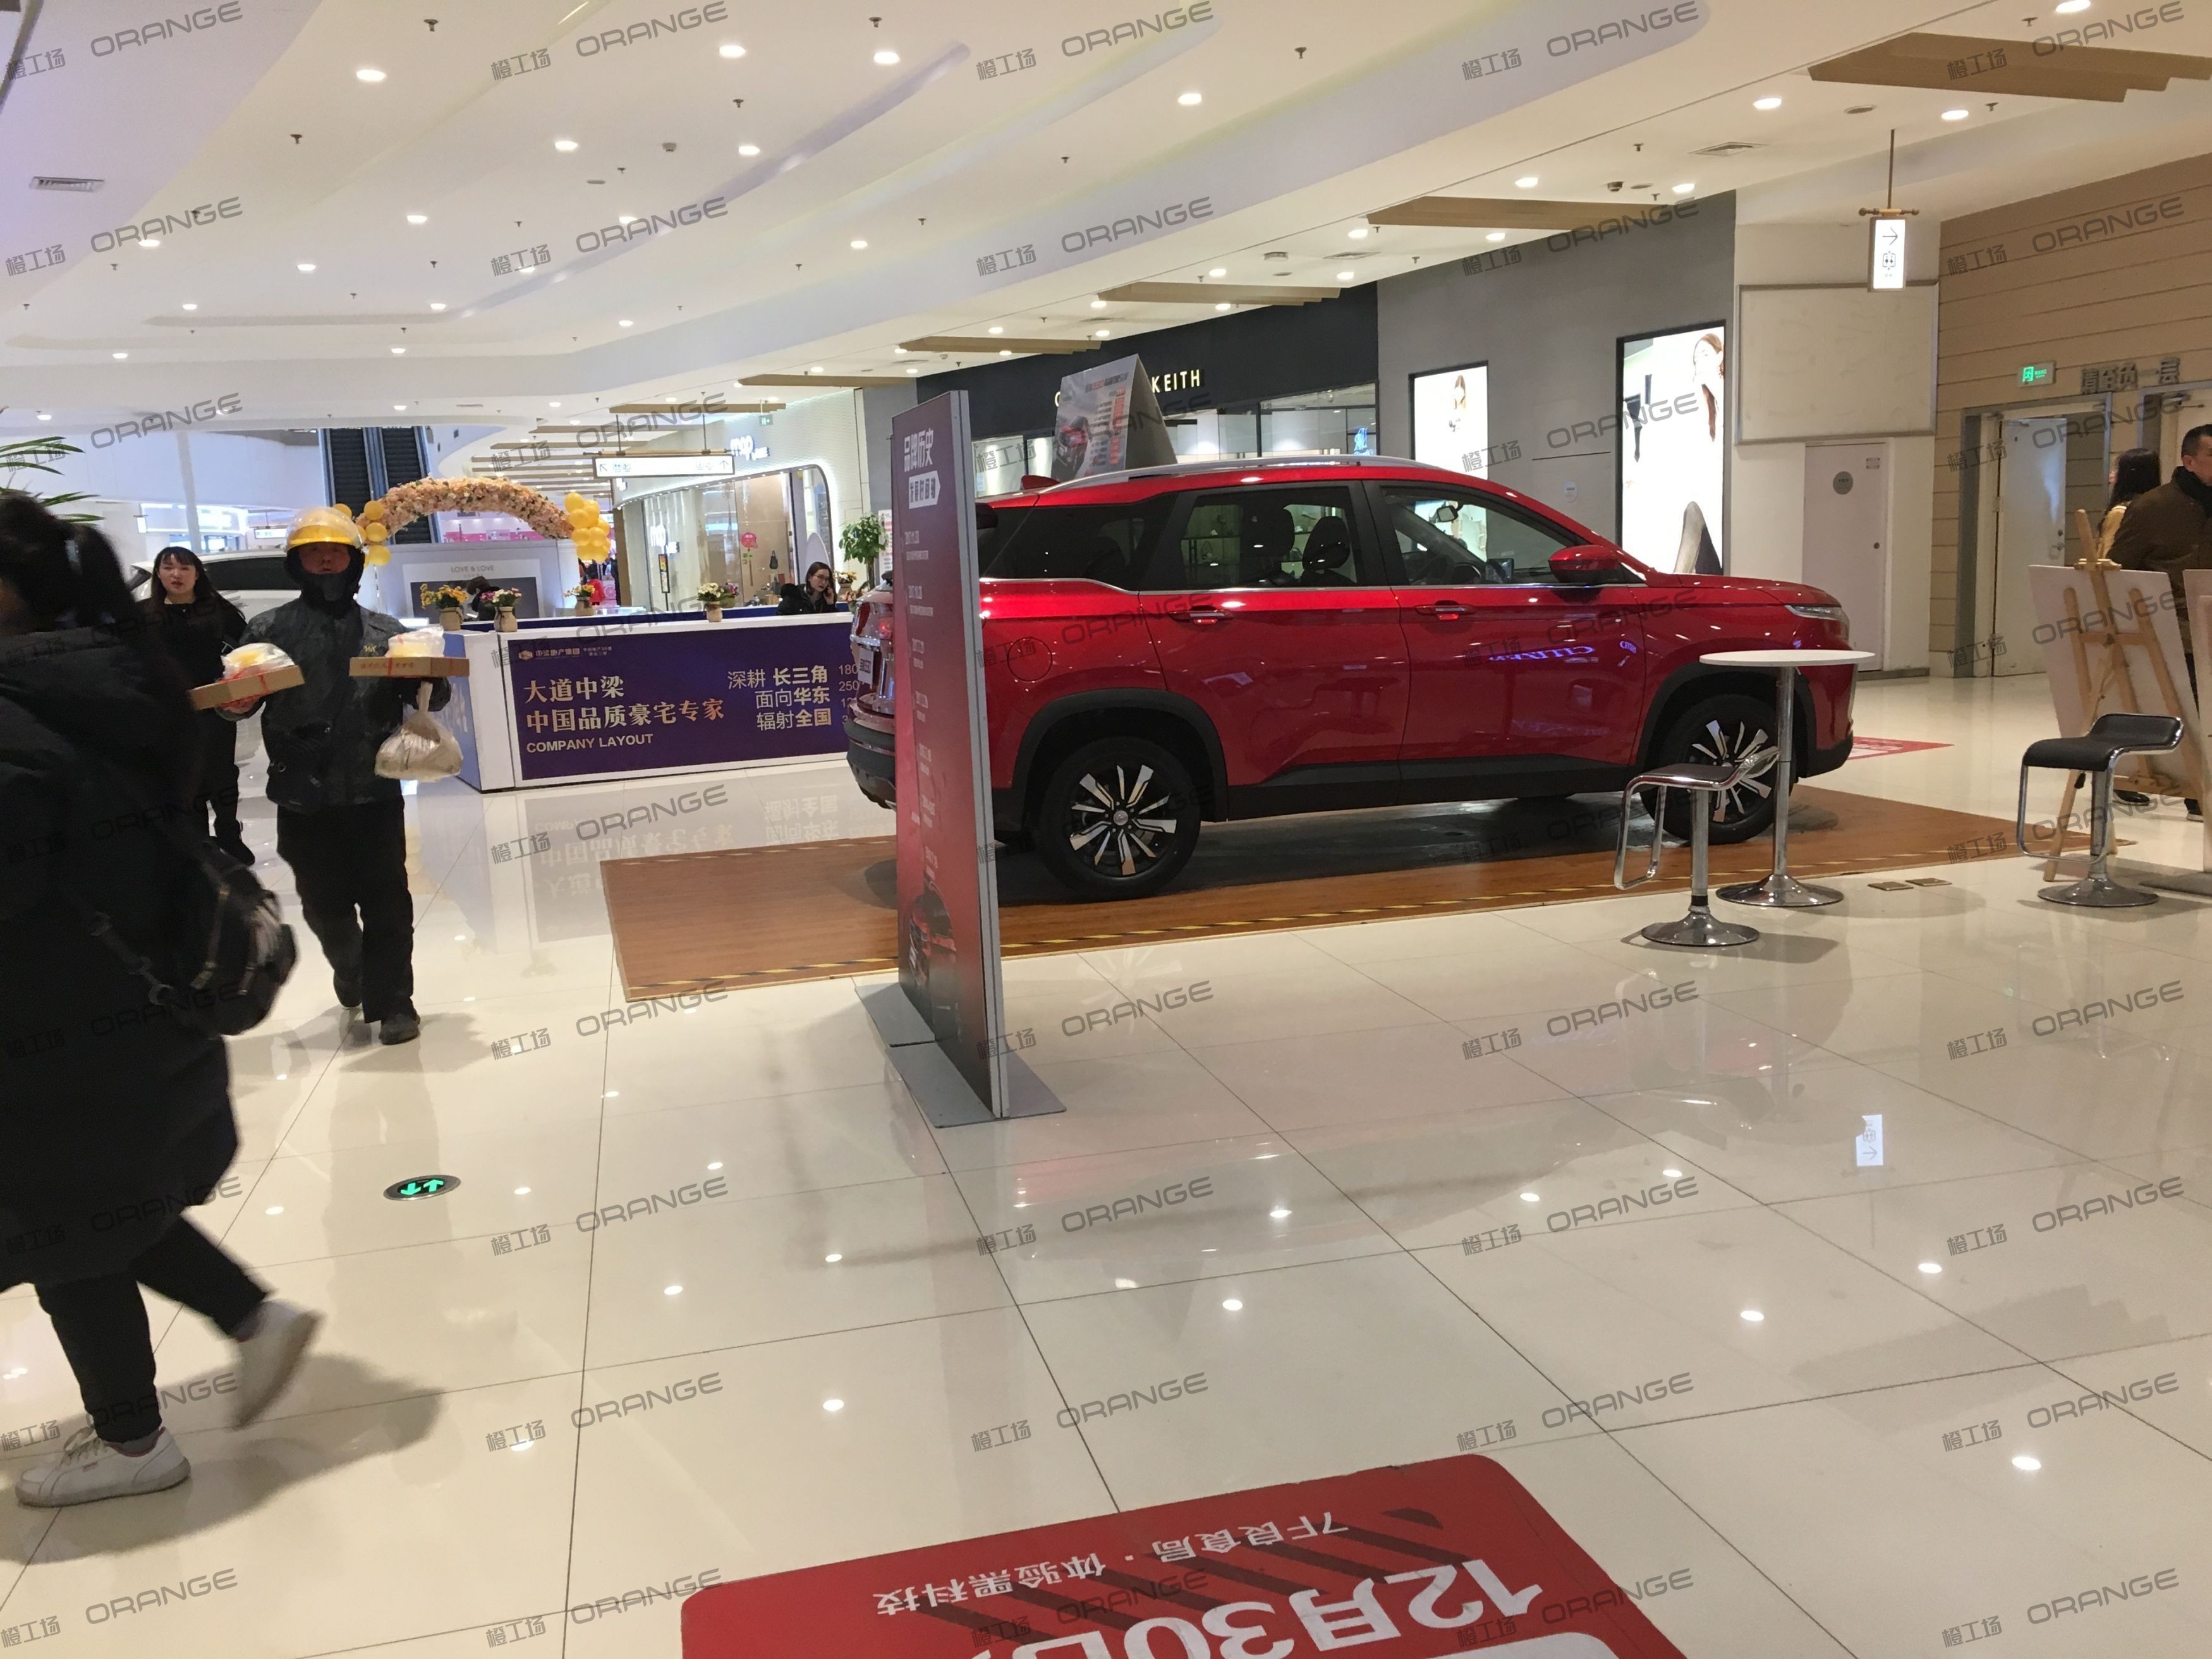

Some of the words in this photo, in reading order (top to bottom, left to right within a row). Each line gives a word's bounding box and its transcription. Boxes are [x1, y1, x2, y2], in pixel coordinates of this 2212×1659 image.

[1152, 369, 1200, 394] KEITH
[524, 675, 625, 703] 大道中梁
[727, 669, 766, 690] 深耕
[773, 665, 828, 686] 长三角
[839, 680, 860, 691] 250
[755, 686, 830, 709] 面向华东
[526, 697, 725, 734] 中国品质豪宅专家
[757, 708, 832, 731] 辐射全国
[526, 738, 595, 753] COMPANY
[599, 733, 653, 748] LAYOUT
